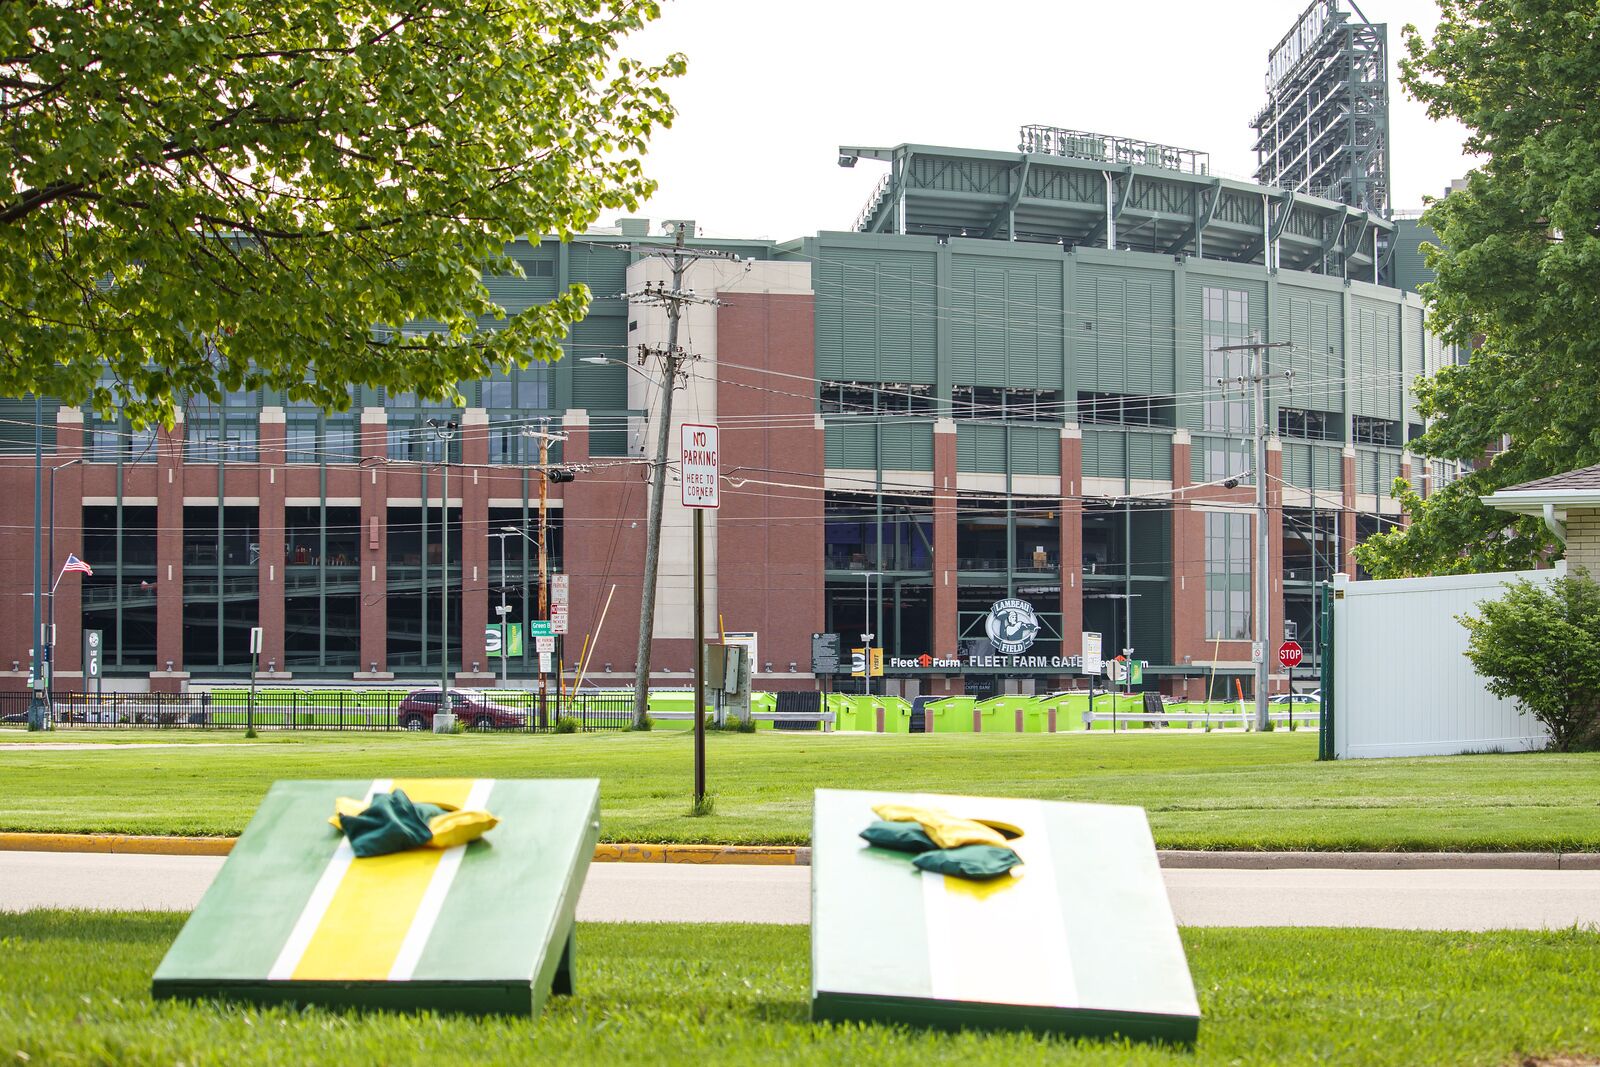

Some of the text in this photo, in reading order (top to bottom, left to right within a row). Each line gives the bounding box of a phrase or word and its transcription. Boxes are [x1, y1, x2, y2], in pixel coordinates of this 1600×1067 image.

[693, 431, 707, 447] NO
[684, 450, 717, 467] PARKING
[686, 473, 714, 485] HERE TO
[687, 486, 714, 497] CORNER
[995, 600, 1030, 612] LAMBEAU
[1001, 643, 1023, 653] FIELD
[1280, 649, 1301, 660] STOP
[90, 658, 98, 675] 6
[890, 657, 961, 668] Fleet Farm
[969, 655, 1009, 668] FLEET
[1012, 655, 1048, 668] FARM
[1051, 655, 1084, 668] GATE
